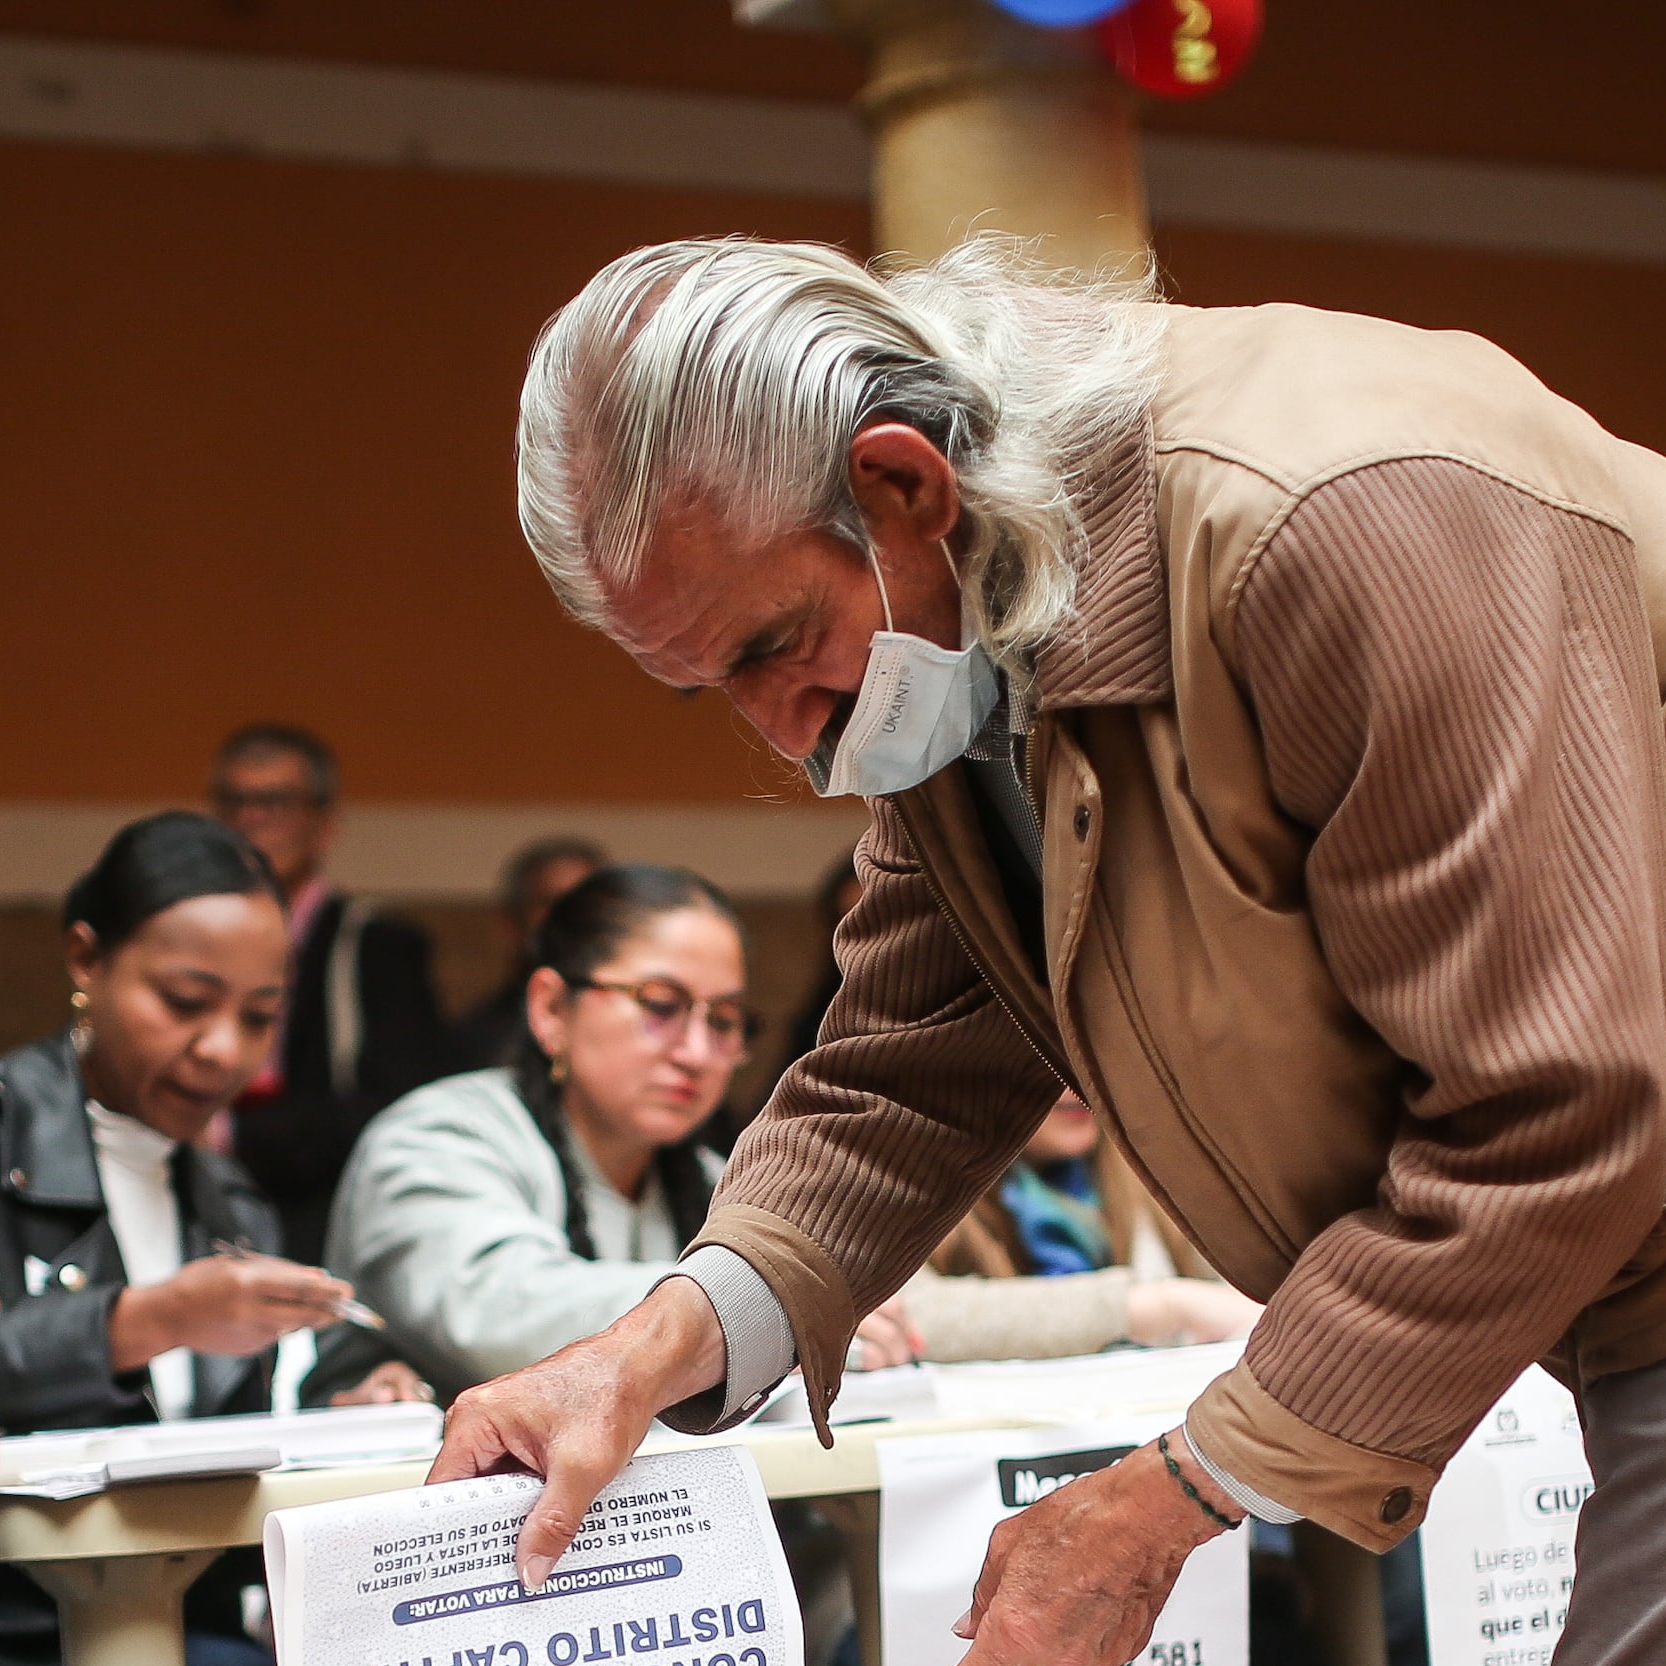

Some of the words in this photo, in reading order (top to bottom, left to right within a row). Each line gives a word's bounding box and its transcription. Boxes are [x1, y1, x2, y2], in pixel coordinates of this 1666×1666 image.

[670, 1487, 688, 1501] EL
[1015, 1470, 1095, 1504] Mes
[608, 1513, 628, 1529] EL
[630, 1503, 692, 1525] MARQUE
[468, 1522, 487, 1538] DE
[490, 1514, 528, 1533] DATO
[576, 1517, 606, 1534] REC
[674, 1521, 695, 1536] SU
[696, 1518, 712, 1532] SI
[446, 1527, 467, 1542] SU
[606, 1532, 626, 1547] ES
[629, 1524, 672, 1543] LISTA
[437, 1542, 478, 1560] LISTA
[480, 1537, 500, 1551] LA
[570, 1536, 603, 1553] CON
[371, 1553, 422, 1573] LUEGO
[424, 1550, 435, 1563] Y
[427, 1550, 519, 1579] PREFERENTE
[1474, 1546, 1537, 1573] Luego
[1544, 1541, 1569, 1563] de
[353, 1565, 428, 1595] (ABIERTA)
[472, 1584, 520, 1605] PARA
[1478, 1582, 1496, 1604] al
[407, 1593, 471, 1618] VOTAR:
[1481, 1618, 1523, 1643] que
[1531, 1610, 1549, 1630] el
